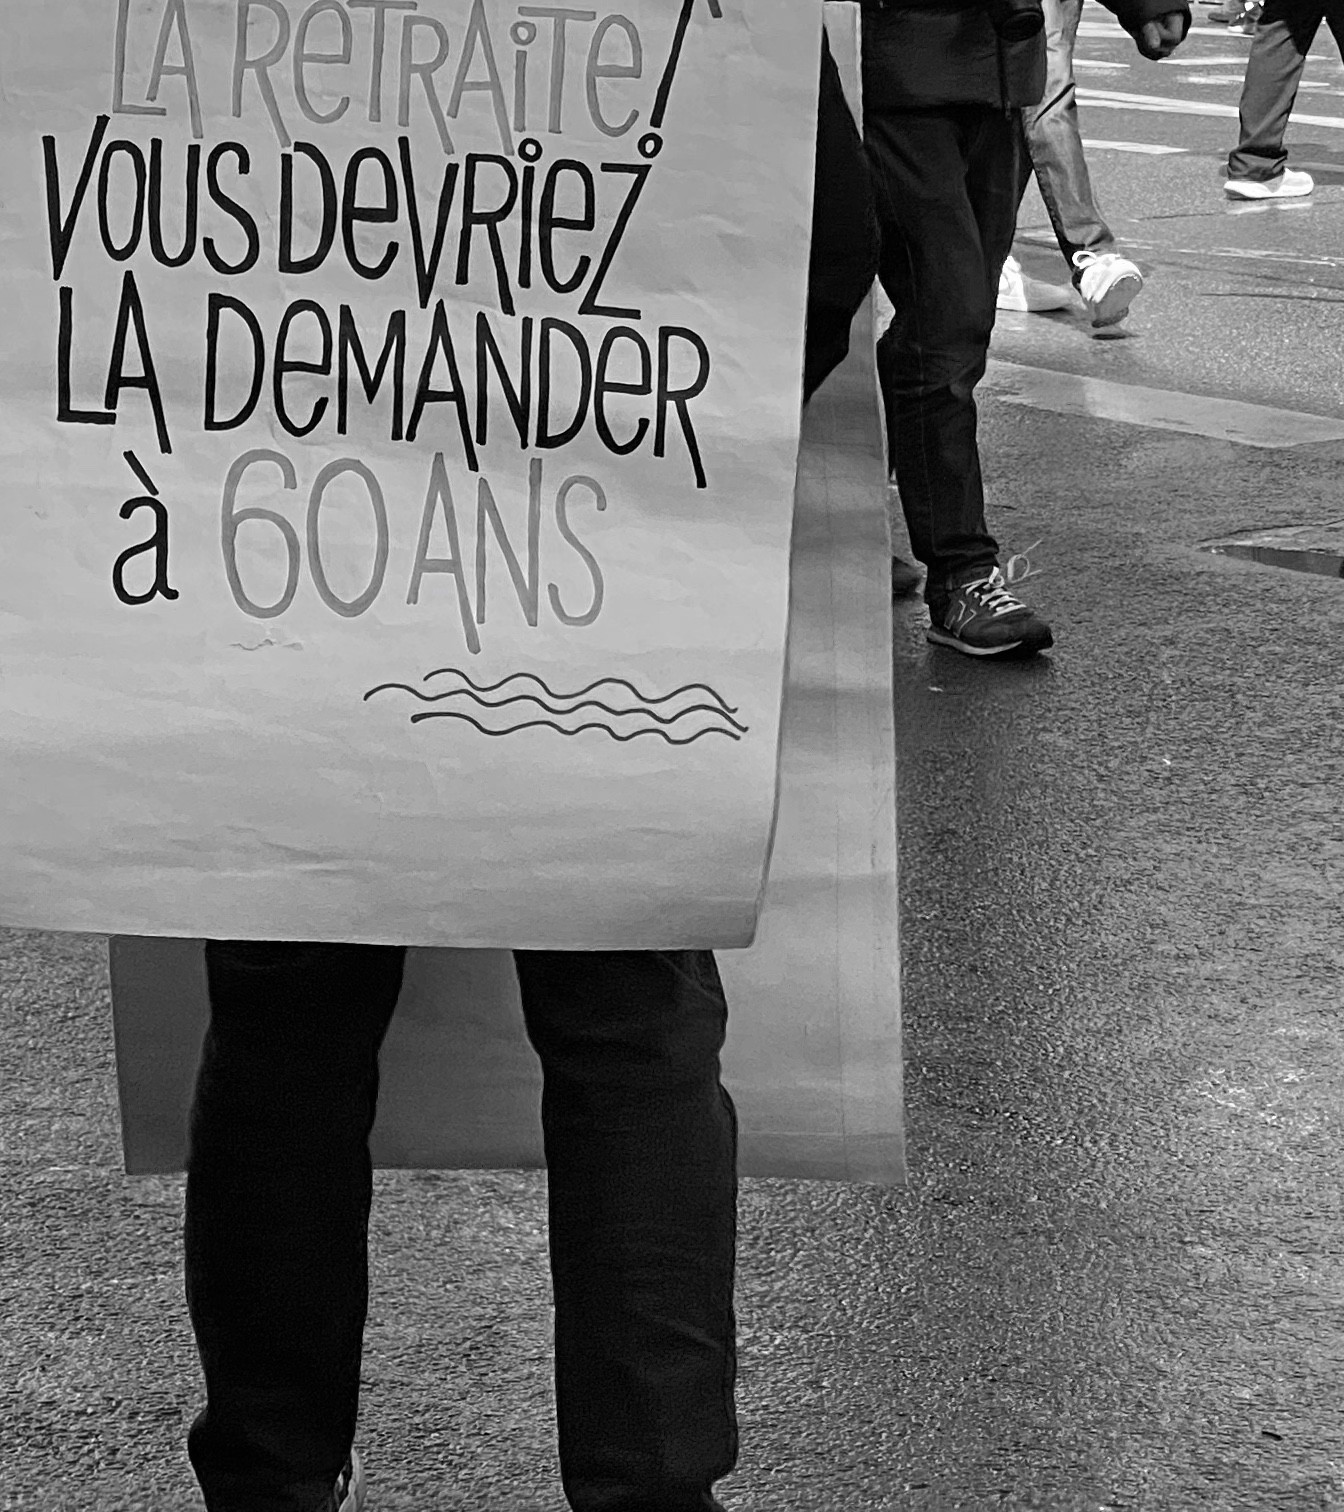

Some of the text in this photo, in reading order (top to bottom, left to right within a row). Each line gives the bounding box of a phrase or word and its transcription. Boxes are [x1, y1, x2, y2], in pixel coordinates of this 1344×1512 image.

[42, 115, 260, 279] VOUS
[56, 271, 172, 454] LA
[112, 448, 608, 654] à 60 ANS
